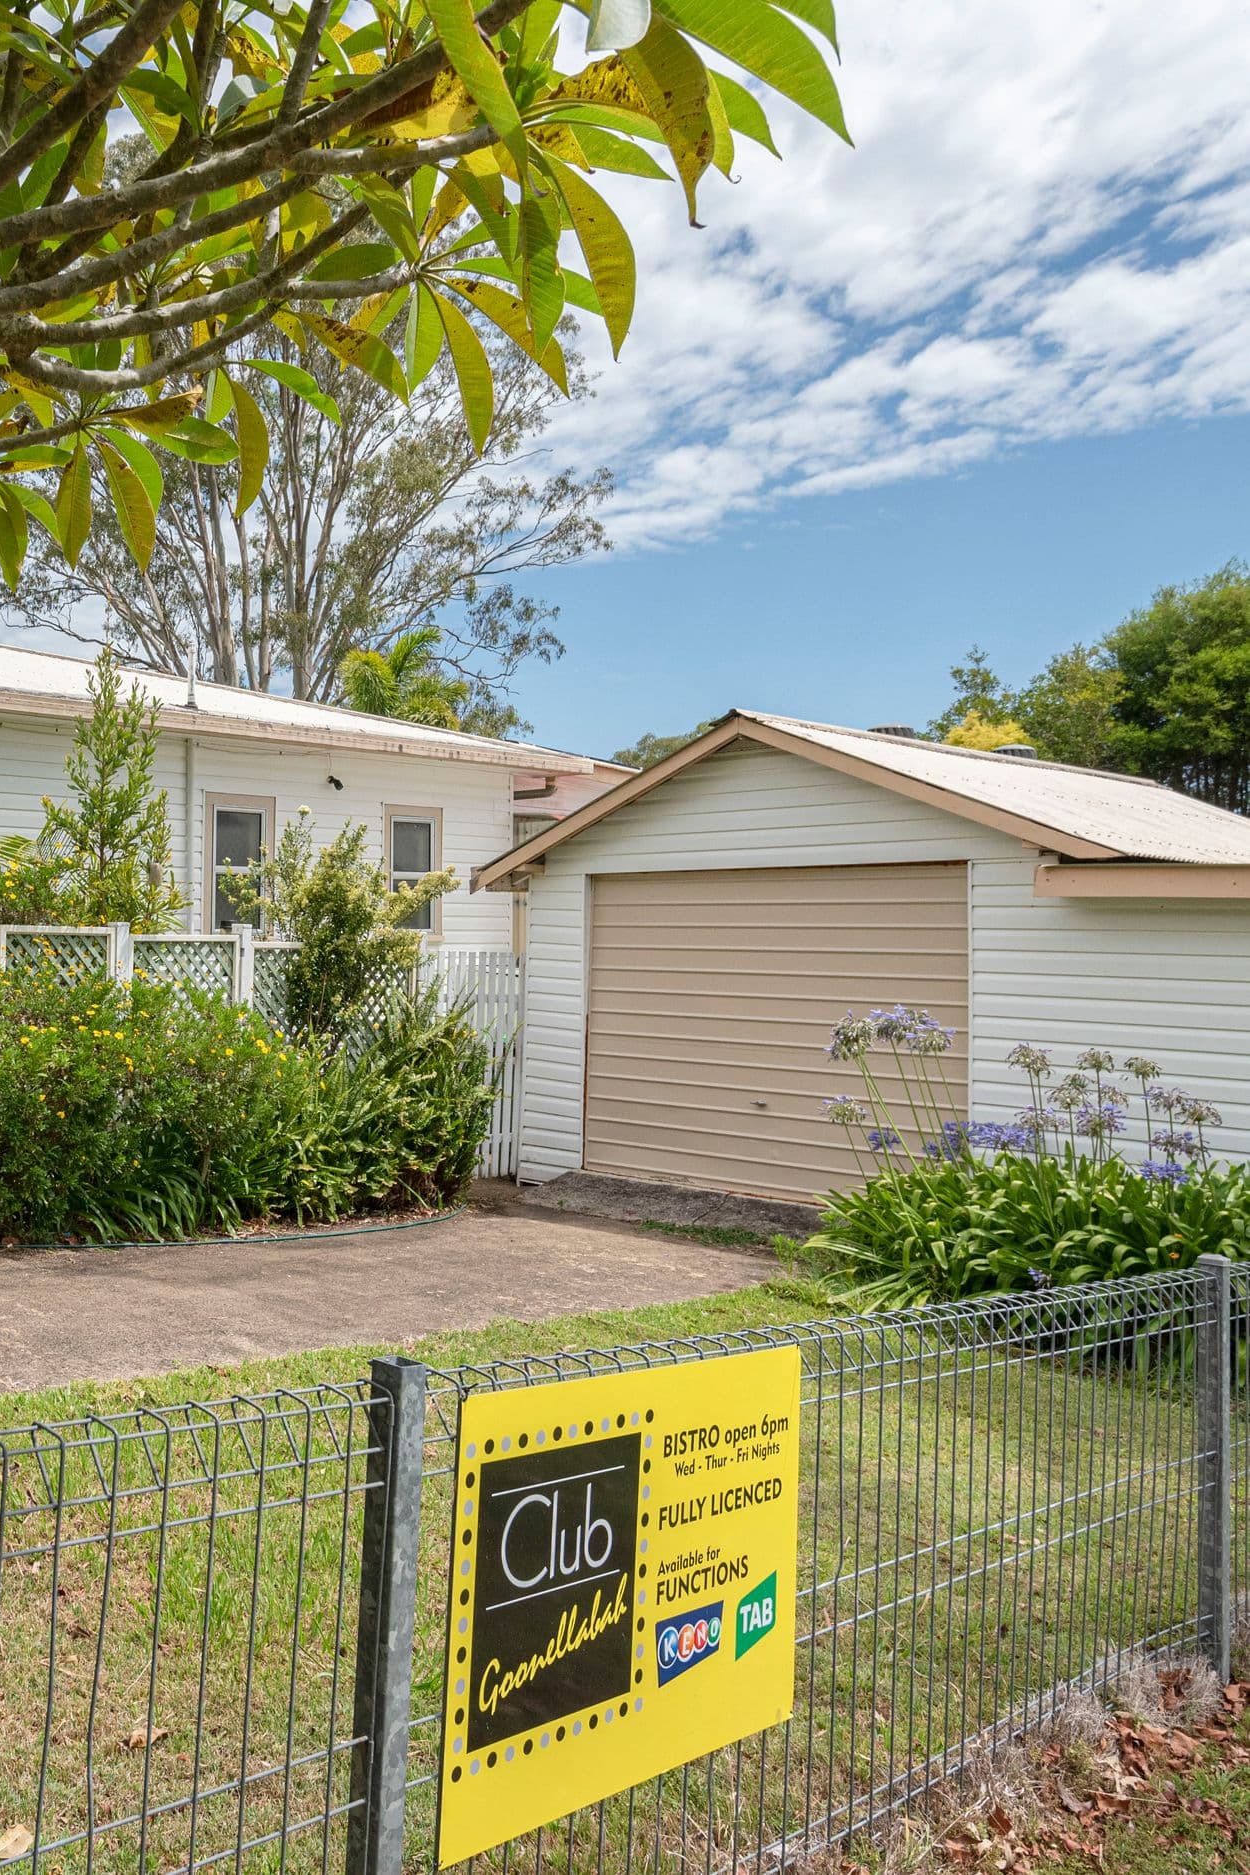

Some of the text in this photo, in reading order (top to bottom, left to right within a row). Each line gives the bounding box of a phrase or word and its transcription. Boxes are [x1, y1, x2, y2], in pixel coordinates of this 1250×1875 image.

[663, 1414, 789, 1458] BISTRO open 6pm
[674, 1459, 696, 1477] Wed
[705, 1454, 728, 1470] Thur
[736, 1447, 749, 1463] Fri
[751, 1441, 780, 1461] Nights
[658, 1478, 783, 1531] FULLY LICENCED
[501, 1482, 612, 1588] Club
[656, 1555, 749, 1606] FUNCTIONS
[657, 1546, 721, 1577] Available for
[739, 1597, 773, 1633] TAB
[478, 1572, 627, 1716] Goonellabah
[662, 1618, 719, 1663] KENO
